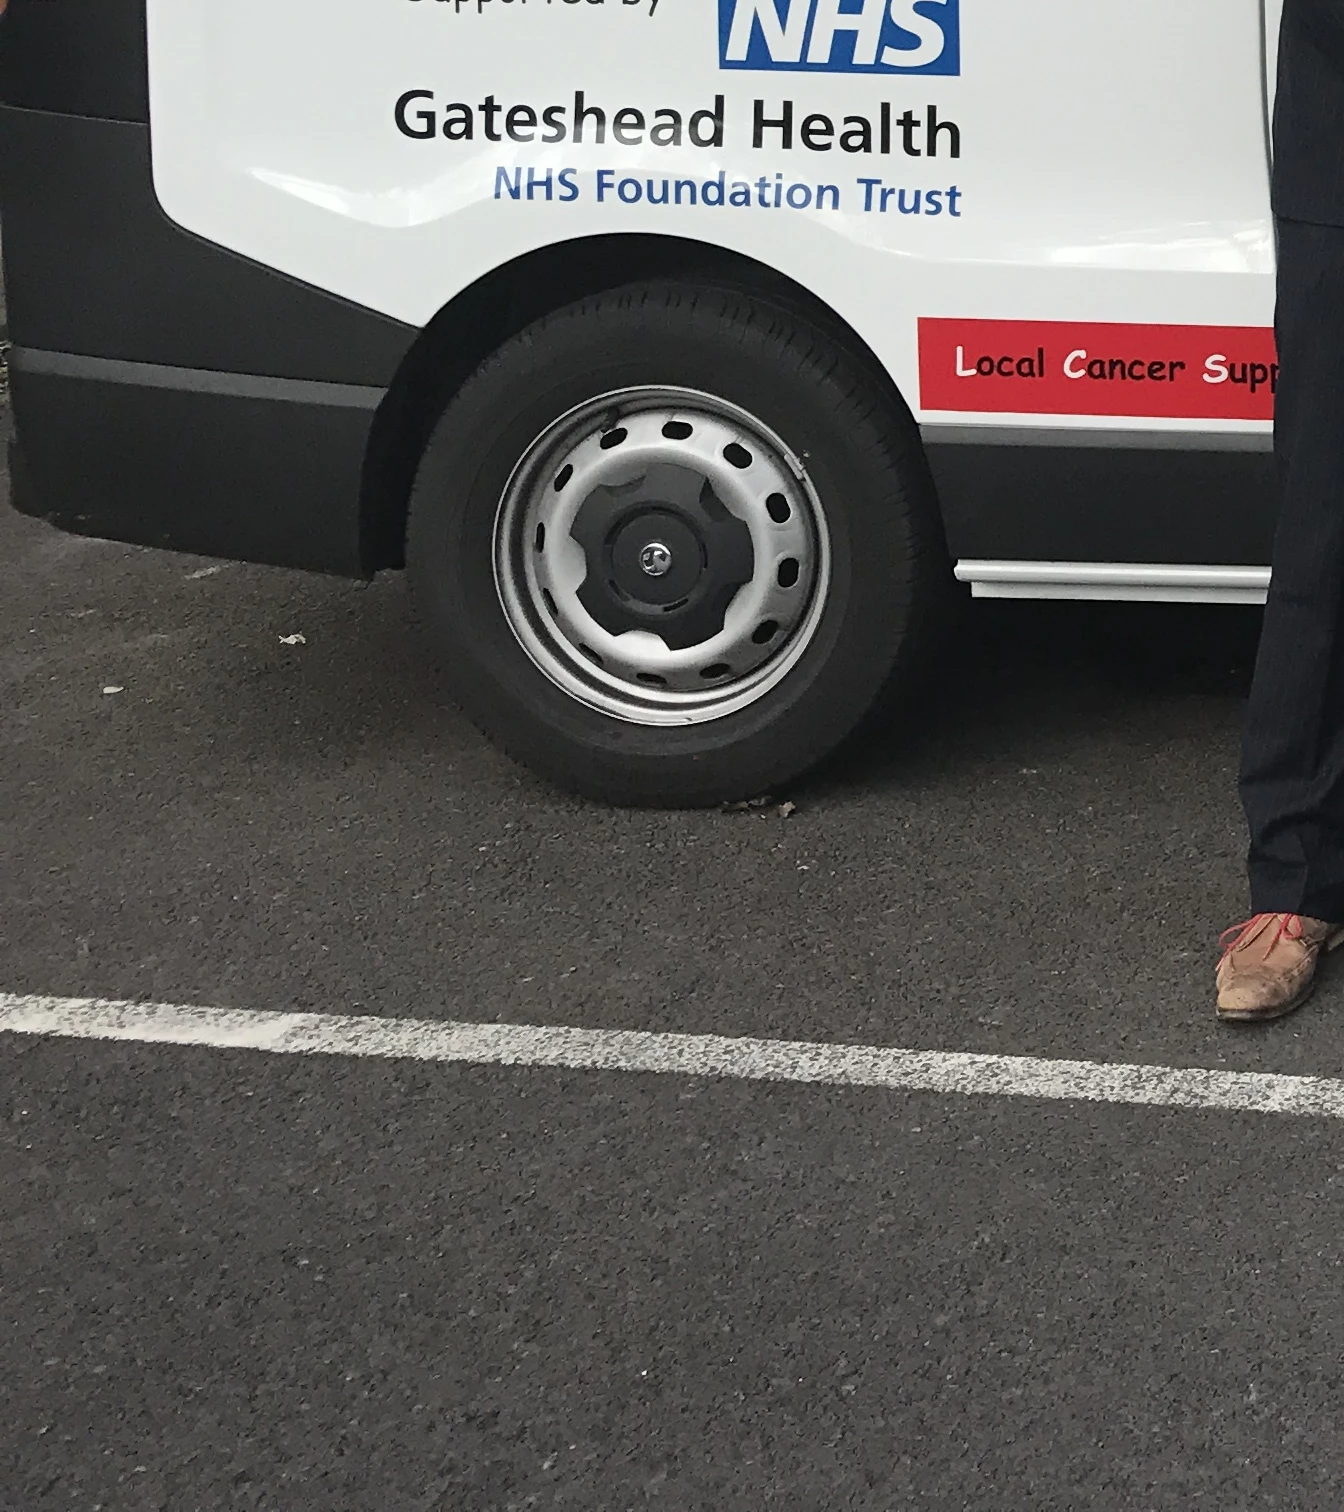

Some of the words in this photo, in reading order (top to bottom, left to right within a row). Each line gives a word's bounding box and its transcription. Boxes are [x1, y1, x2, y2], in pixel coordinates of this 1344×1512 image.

[394, 89, 725, 148] Gateshead
[752, 98, 961, 159] Health
[493, 166, 580, 202] NHS
[596, 169, 840, 211] Foundation
[856, 177, 962, 218] Trust
[954, 344, 1045, 378] Local
[1062, 348, 1186, 382] Cancer
